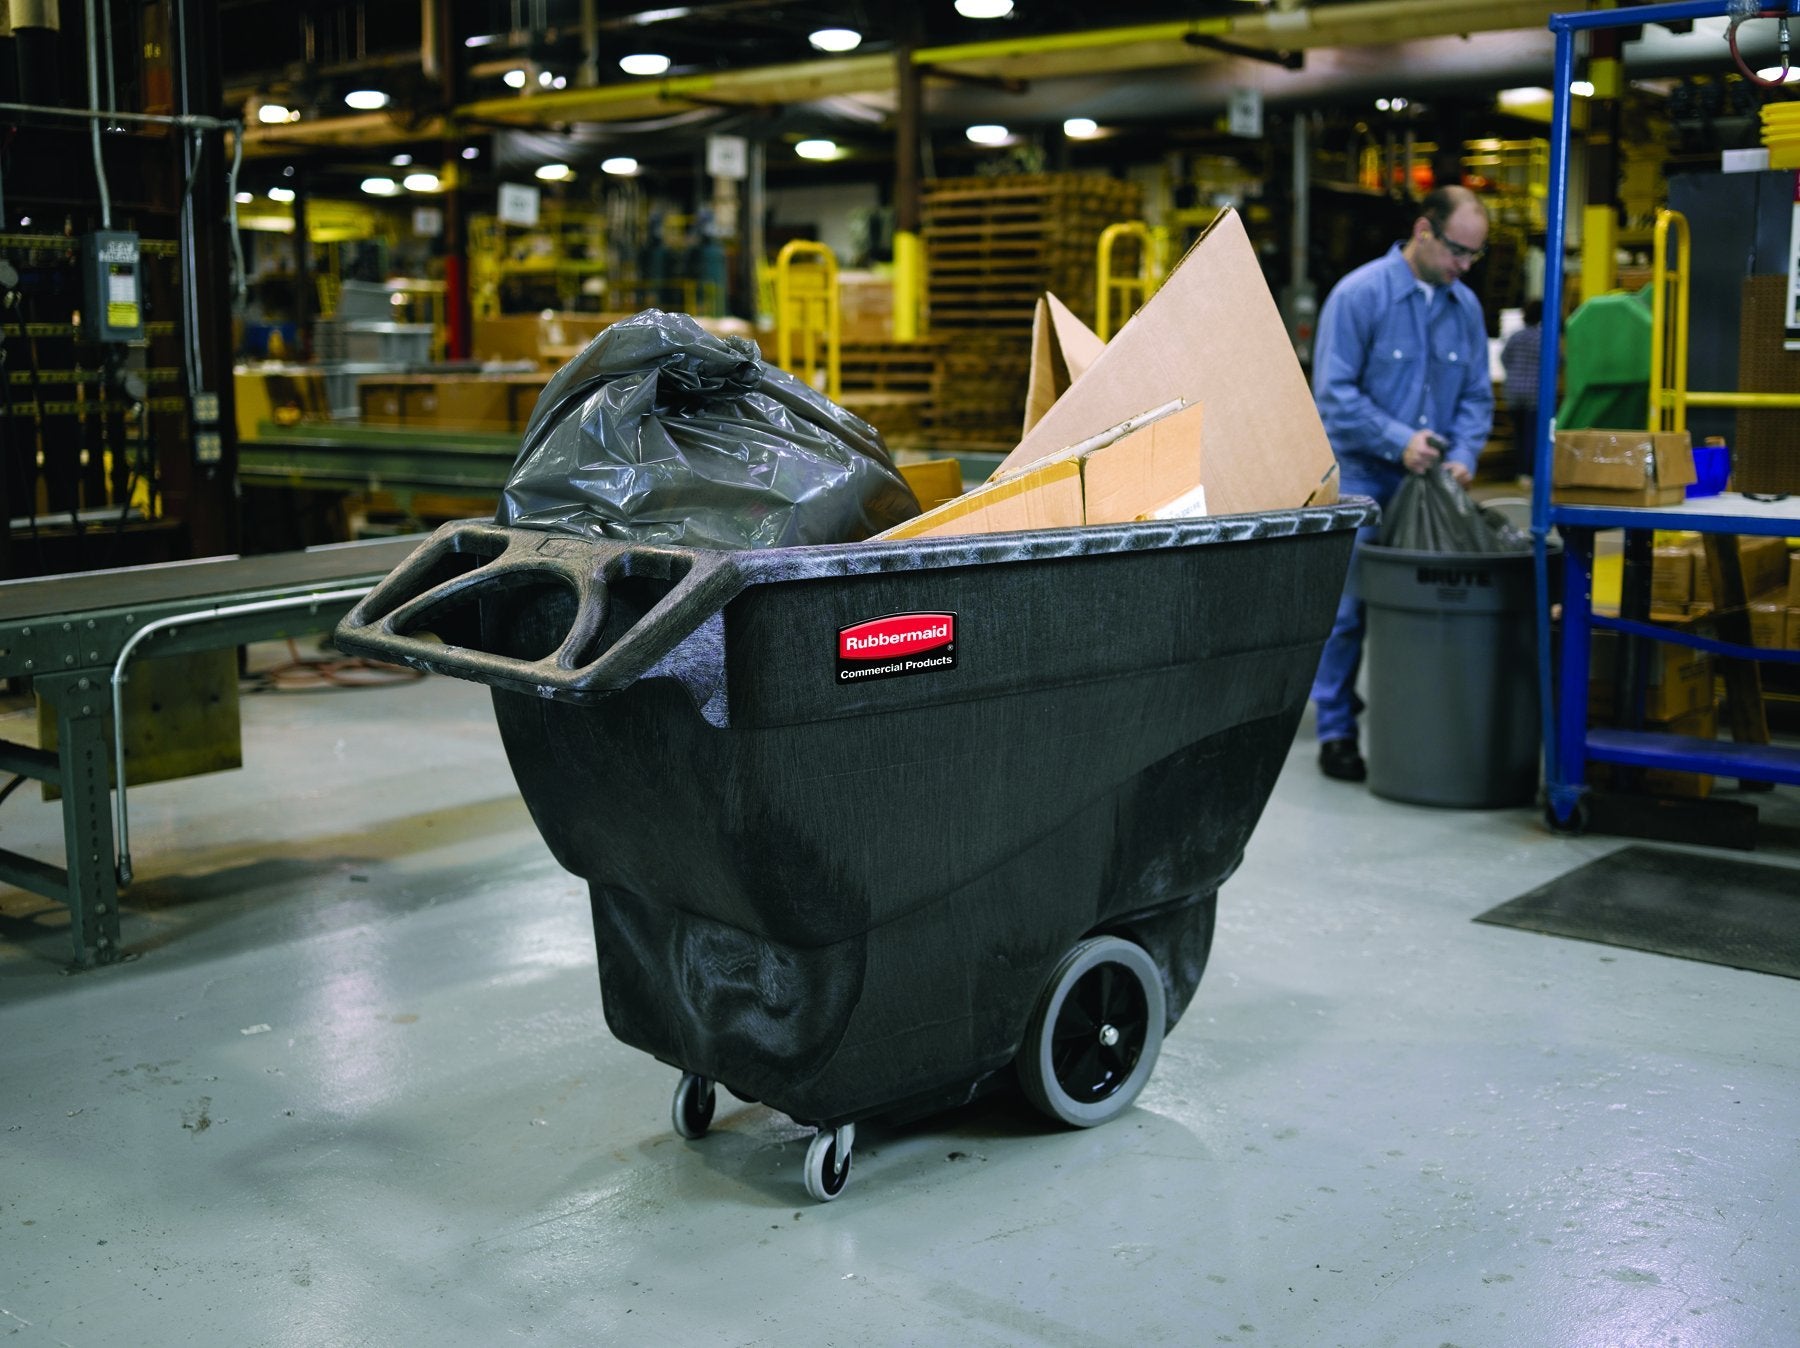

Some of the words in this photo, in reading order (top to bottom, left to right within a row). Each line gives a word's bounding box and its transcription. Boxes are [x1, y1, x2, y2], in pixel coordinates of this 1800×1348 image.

[846, 624, 947, 650] Rubbermaid
[840, 663, 903, 679] Commercial
[905, 656, 952, 670] Products
